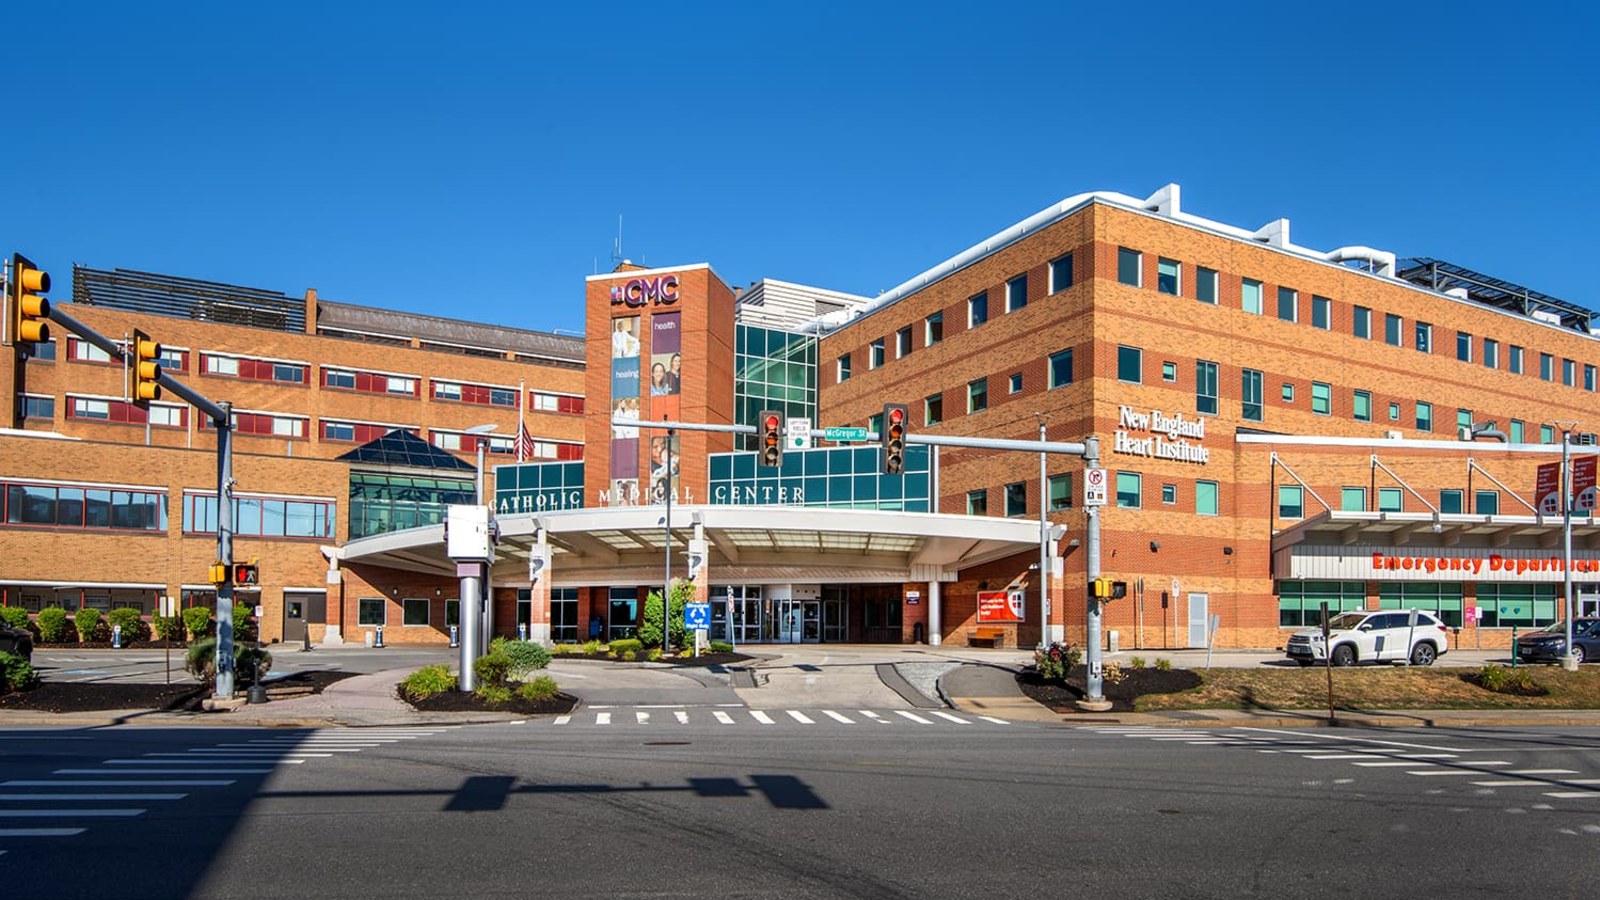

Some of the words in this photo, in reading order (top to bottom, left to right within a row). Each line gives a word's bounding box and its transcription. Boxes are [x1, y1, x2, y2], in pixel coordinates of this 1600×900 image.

[625, 275, 678, 307] CMC
[654, 320, 676, 331] health
[615, 369, 640, 381] healing
[826, 429, 856, 439] McGregor
[859, 430, 866, 438] St
[1118, 405, 1150, 430] New
[1151, 410, 1205, 440] England
[1114, 430, 1154, 457] Heart
[1154, 436, 1210, 464] Institute
[488, 491, 580, 511] CATHOLIC
[599, 486, 694, 503] MEDICAL
[715, 486, 803, 501] CENTER
[1372, 553, 1483, 574] Emergency
[1489, 554, 1600, 575] Departmen
